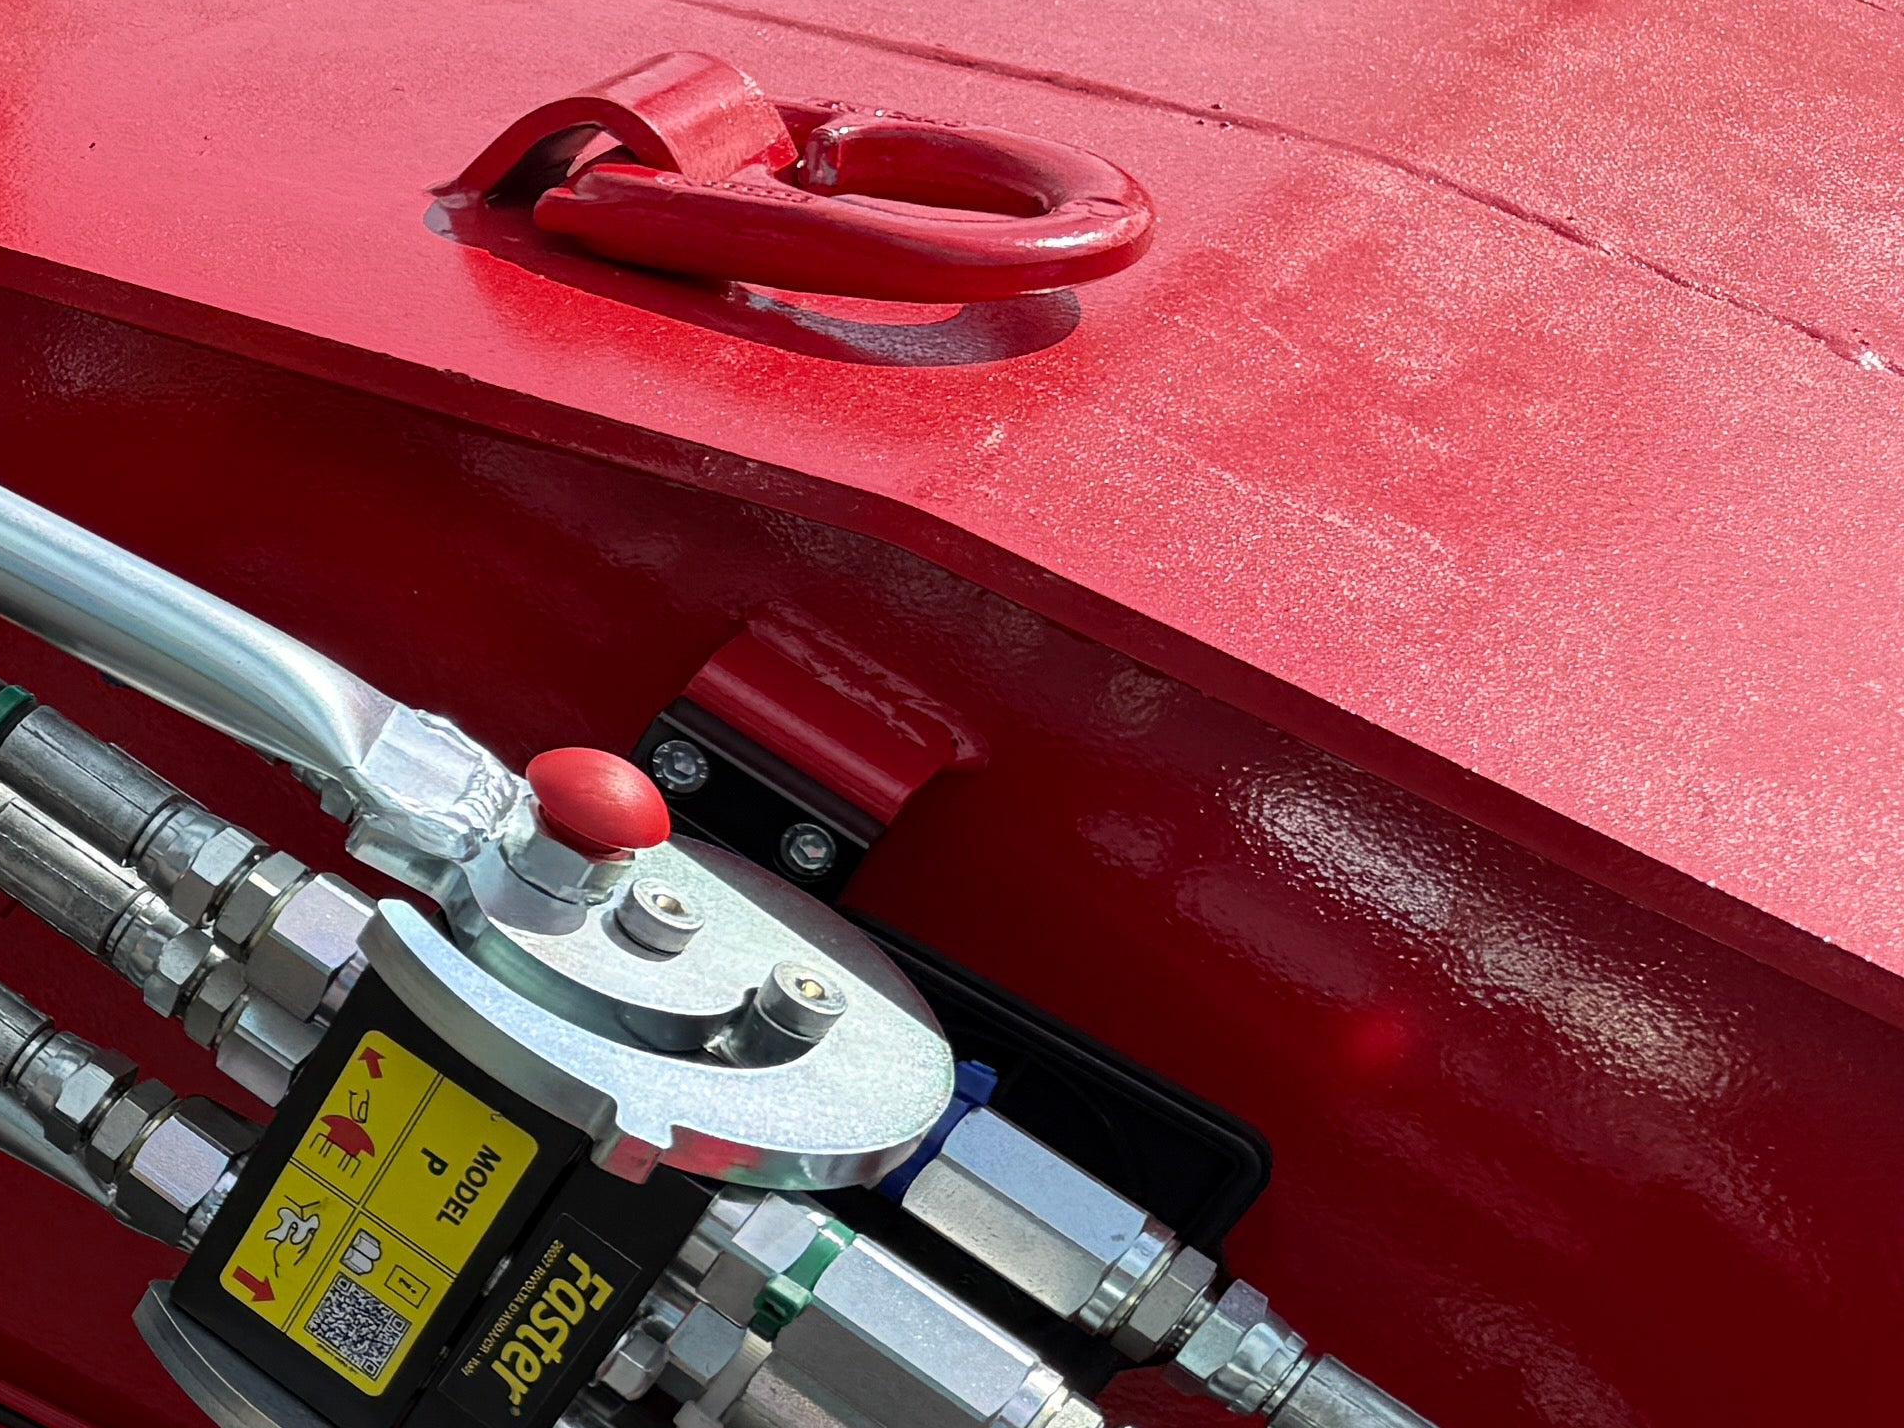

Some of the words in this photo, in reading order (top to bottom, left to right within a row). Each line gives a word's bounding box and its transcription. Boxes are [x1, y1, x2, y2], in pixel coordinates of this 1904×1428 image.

[420, 1147, 449, 1175] P
[436, 1144, 502, 1228] MODEL
[491, 1252, 615, 1403] Faster
